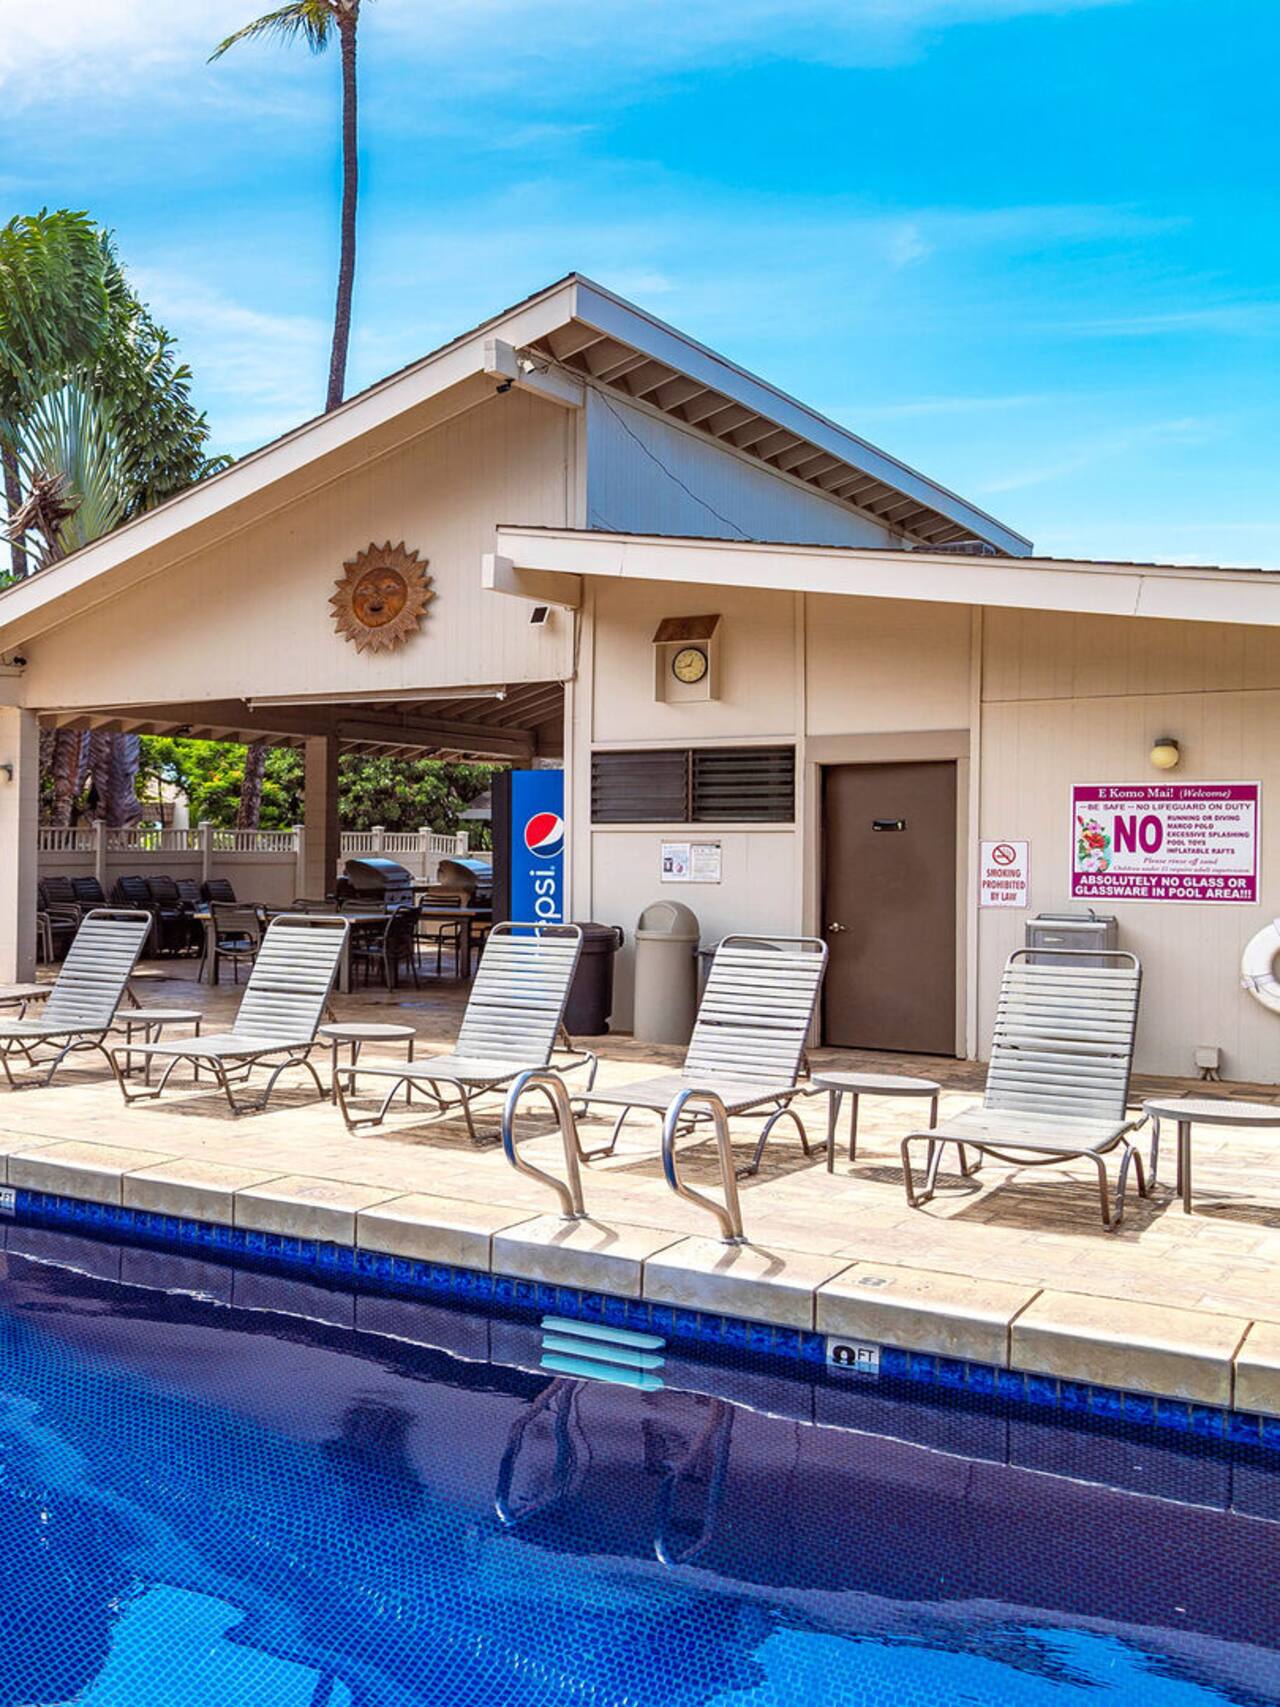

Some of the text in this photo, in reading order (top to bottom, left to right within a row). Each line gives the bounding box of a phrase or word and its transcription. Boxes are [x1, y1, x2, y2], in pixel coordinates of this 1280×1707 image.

[1098, 787, 1232, 799] E Komo Mai! (Welcome)
[1152, 803, 1206, 811] LIFEGUARD
[1114, 815, 1163, 854] NO
[986, 869, 1021, 878] SMOKING
[982, 880, 1026, 890] PROHIBITED
[1080, 875, 1247, 888] ABSOLUTELY NO GLASS OR
[990, 893, 1018, 901] BY LAW
[1075, 885, 1252, 899] GLASSWARE IN POOL AREA!!!
